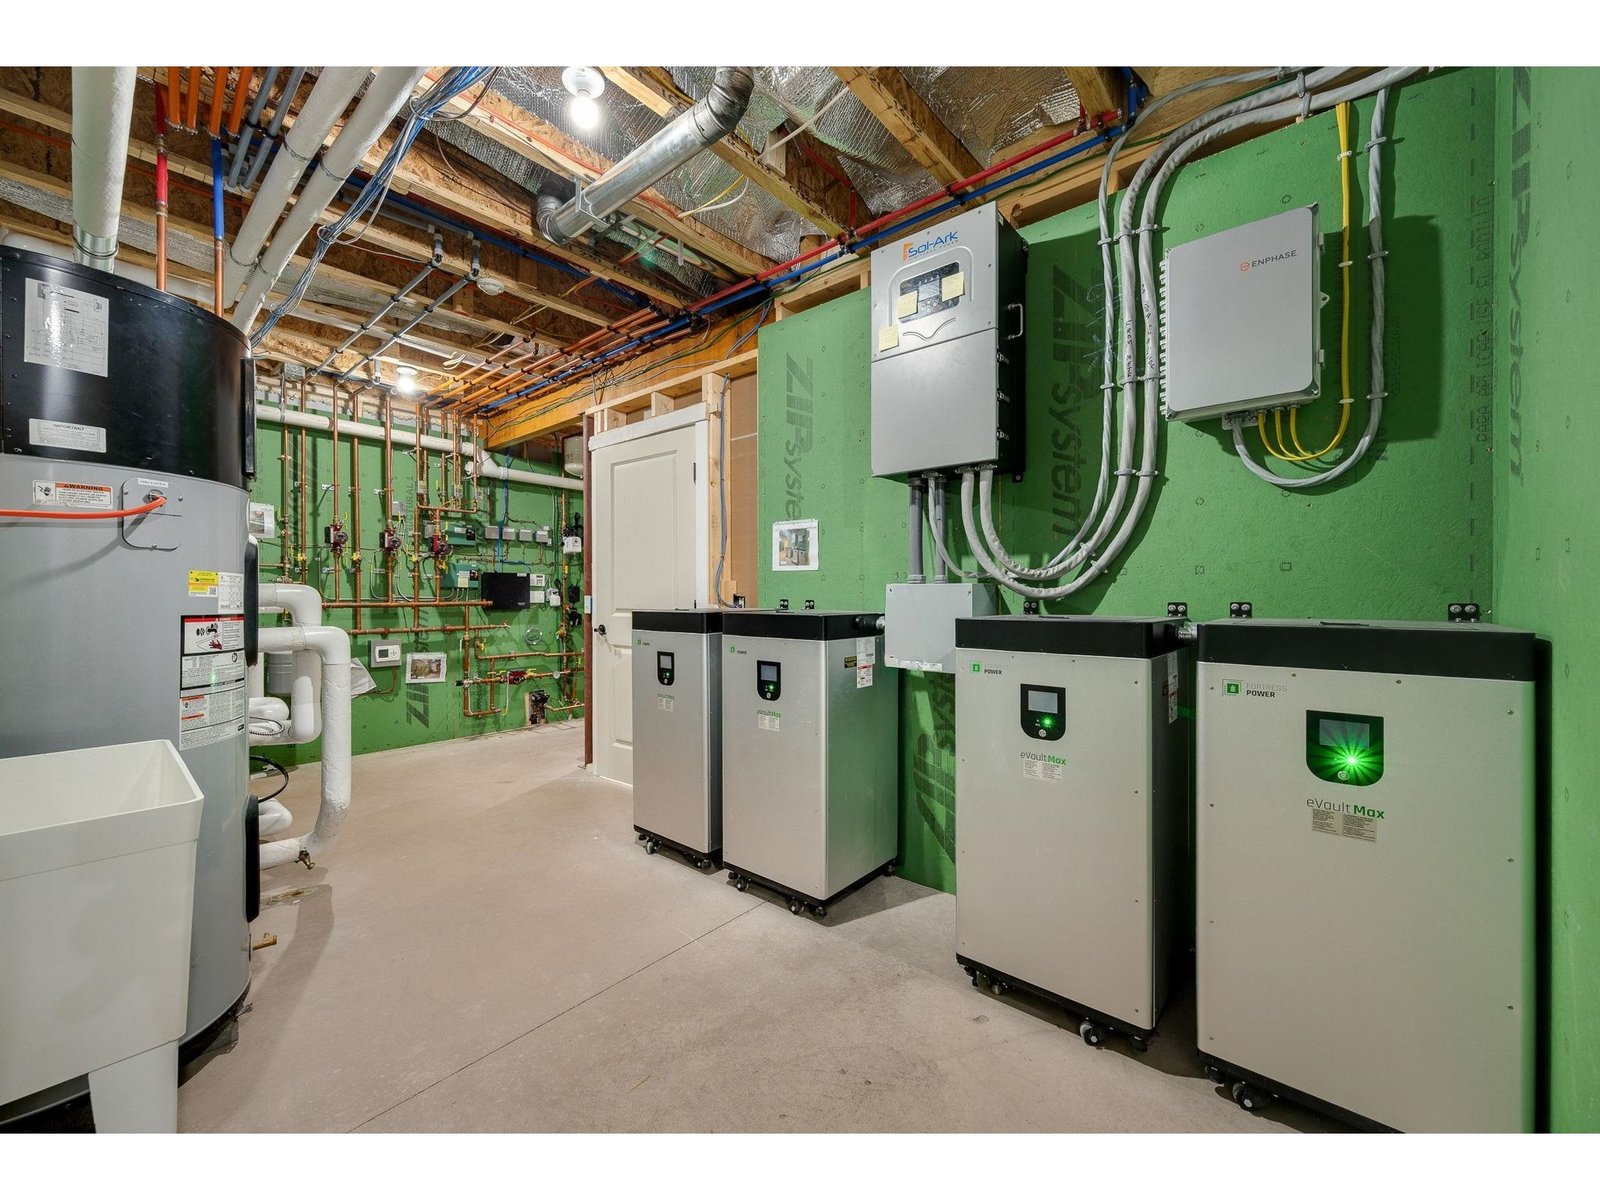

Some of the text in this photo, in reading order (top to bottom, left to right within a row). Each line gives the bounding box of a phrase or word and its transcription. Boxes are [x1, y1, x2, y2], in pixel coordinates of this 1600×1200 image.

[908, 231, 959, 258] Sol-Ark
[1251, 249, 1297, 268] ENPHASE
[68, 483, 104, 491] WARNING
[1246, 682, 1288, 692] FORTRESS
[1246, 689, 1276, 698] POWER
[1020, 751, 1067, 766] eVault Max
[1306, 798, 1385, 820] eVault Max
